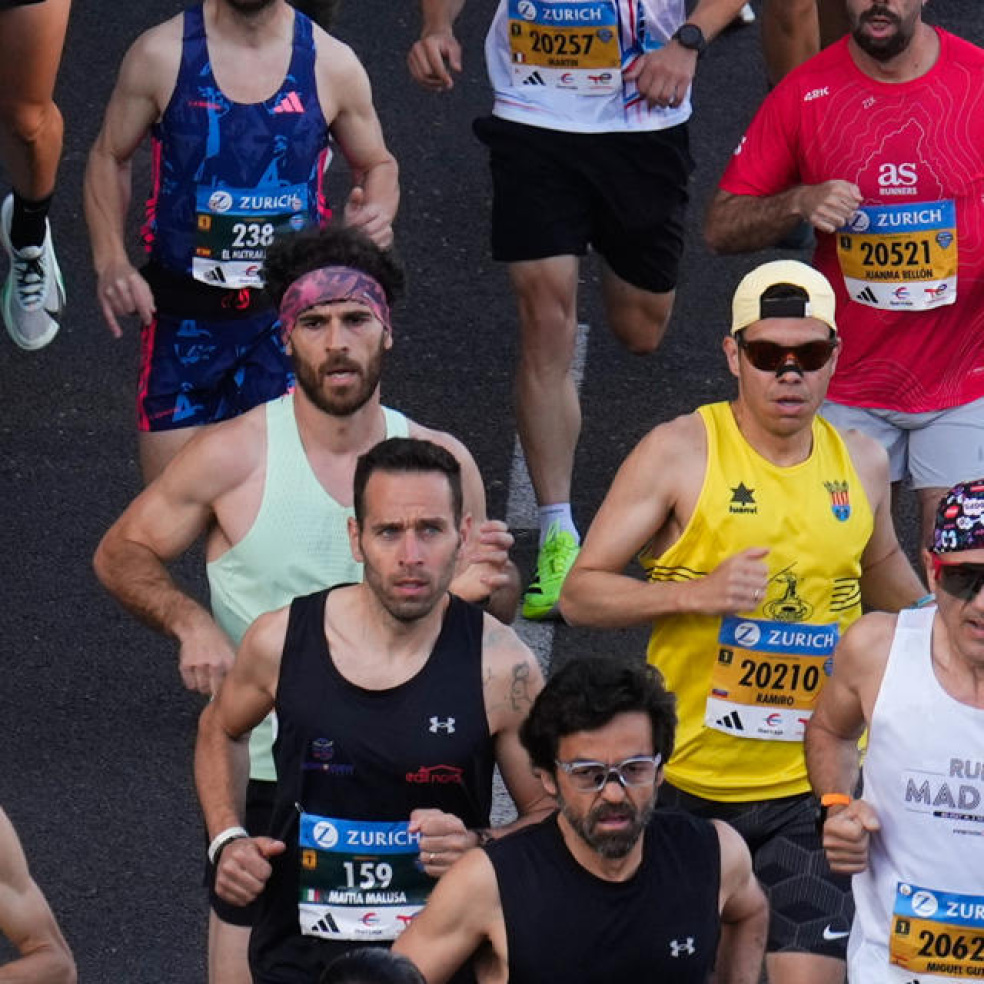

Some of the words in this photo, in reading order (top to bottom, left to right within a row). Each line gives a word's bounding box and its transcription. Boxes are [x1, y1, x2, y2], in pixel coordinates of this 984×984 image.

[541, 6, 602, 22] ZURICH
[529, 29, 596, 58] 20257
[877, 163, 918, 188] as
[239, 193, 296, 210] ZURICH
[877, 208, 943, 228] ZURICH
[231, 223, 275, 248] 238
[860, 239, 931, 268] 20521
[768, 629, 835, 647] ZURICH
[738, 661, 820, 693] 20210
[904, 777, 982, 811] MAD
[347, 828, 422, 846] ZURICH
[342, 862, 393, 890] 159
[945, 902, 984, 920] ZUR
[917, 928, 984, 962] 2062
